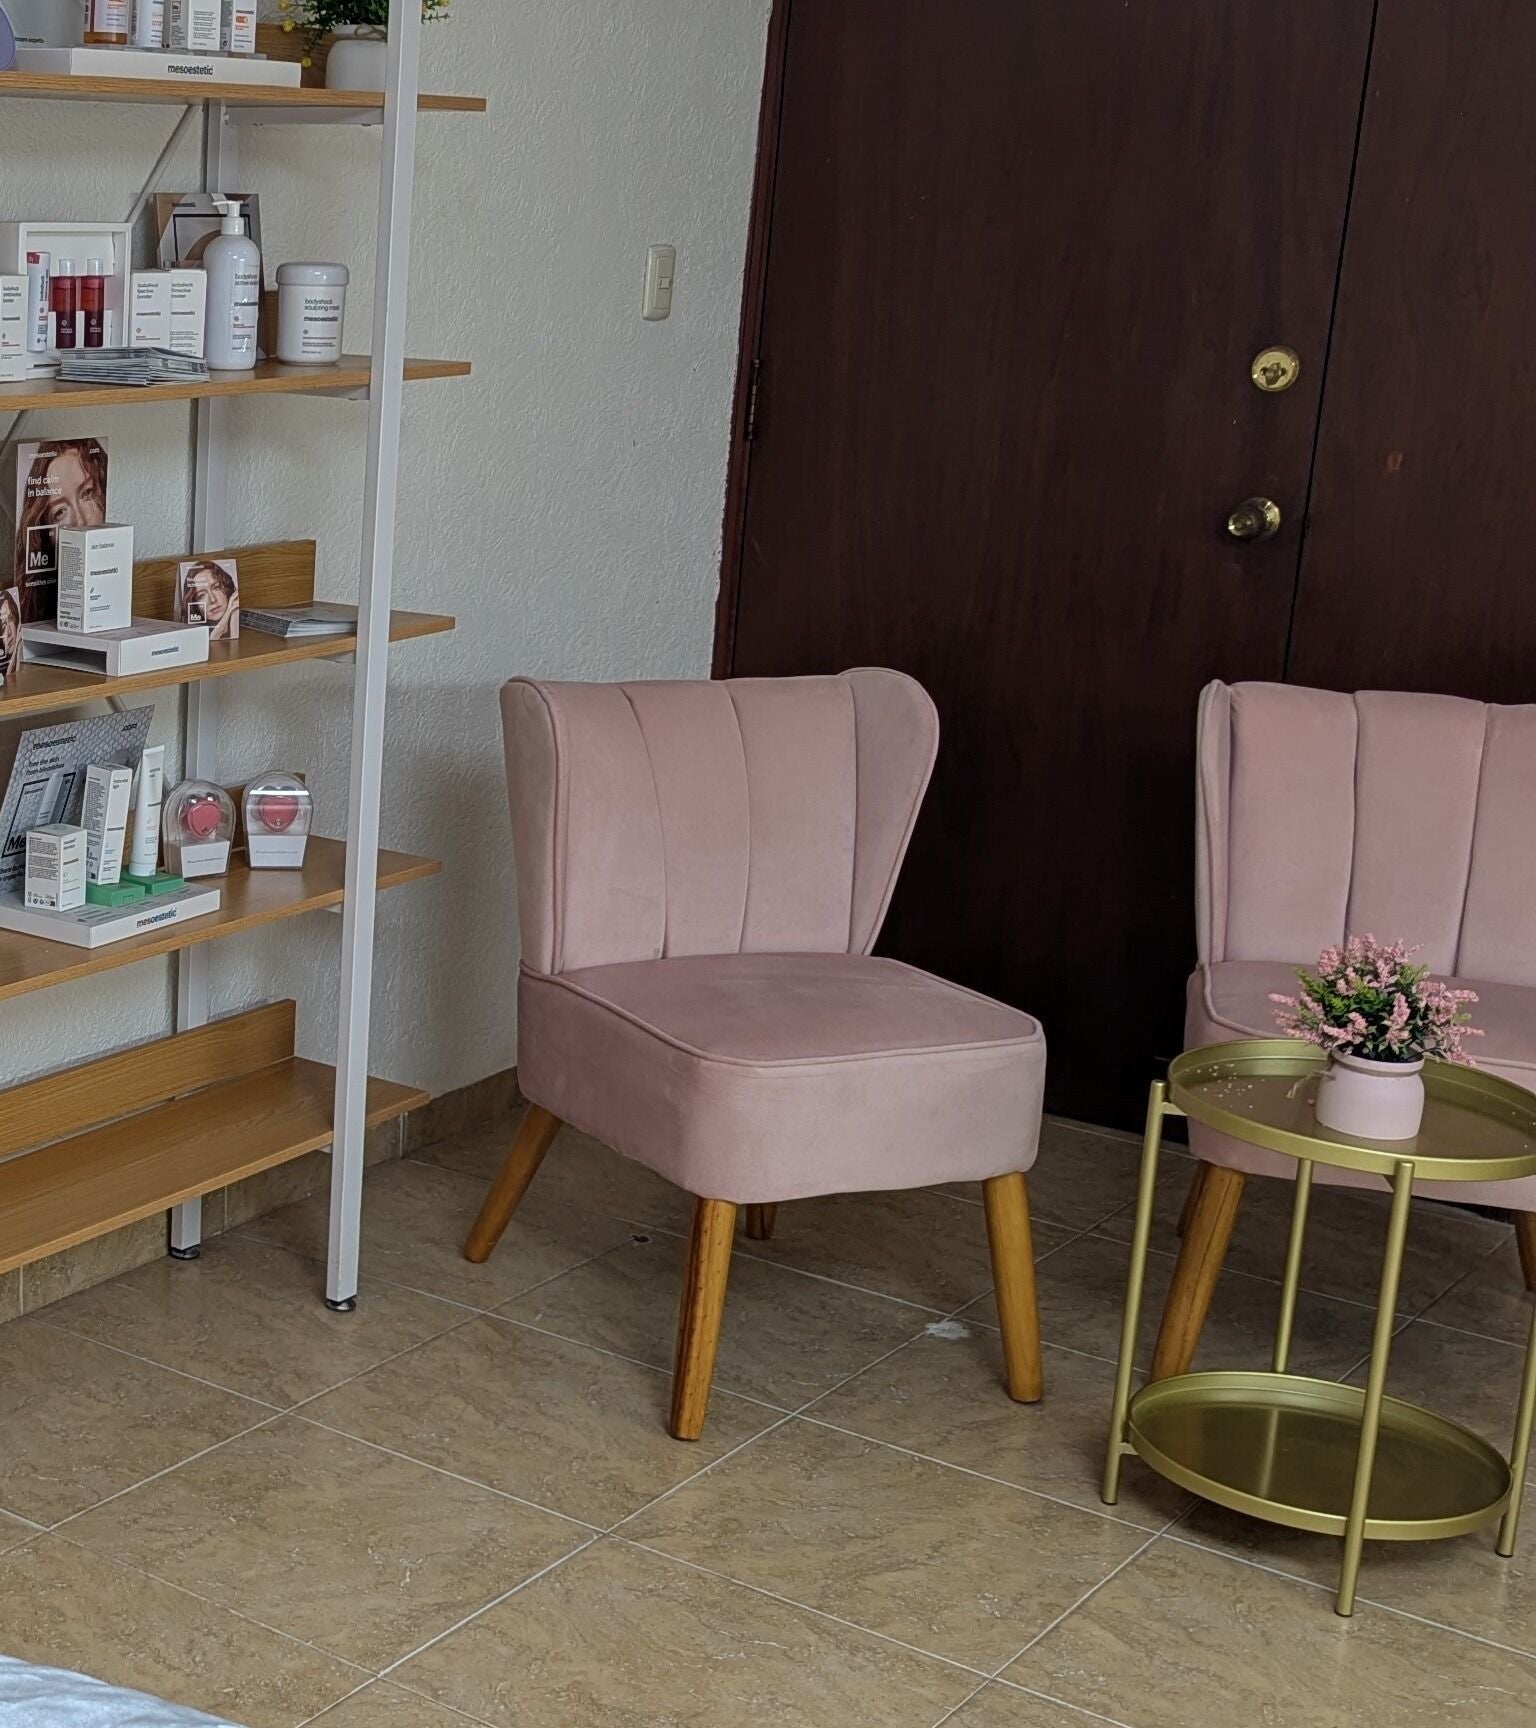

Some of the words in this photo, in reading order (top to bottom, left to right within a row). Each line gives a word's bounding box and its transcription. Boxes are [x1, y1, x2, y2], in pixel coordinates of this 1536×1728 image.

[27, 475, 42, 486] find
[27, 488, 35, 498] in
[35, 486, 63, 497] balance
[29, 551, 49, 568] Me
[136, 909, 177, 929] mesoestetic
